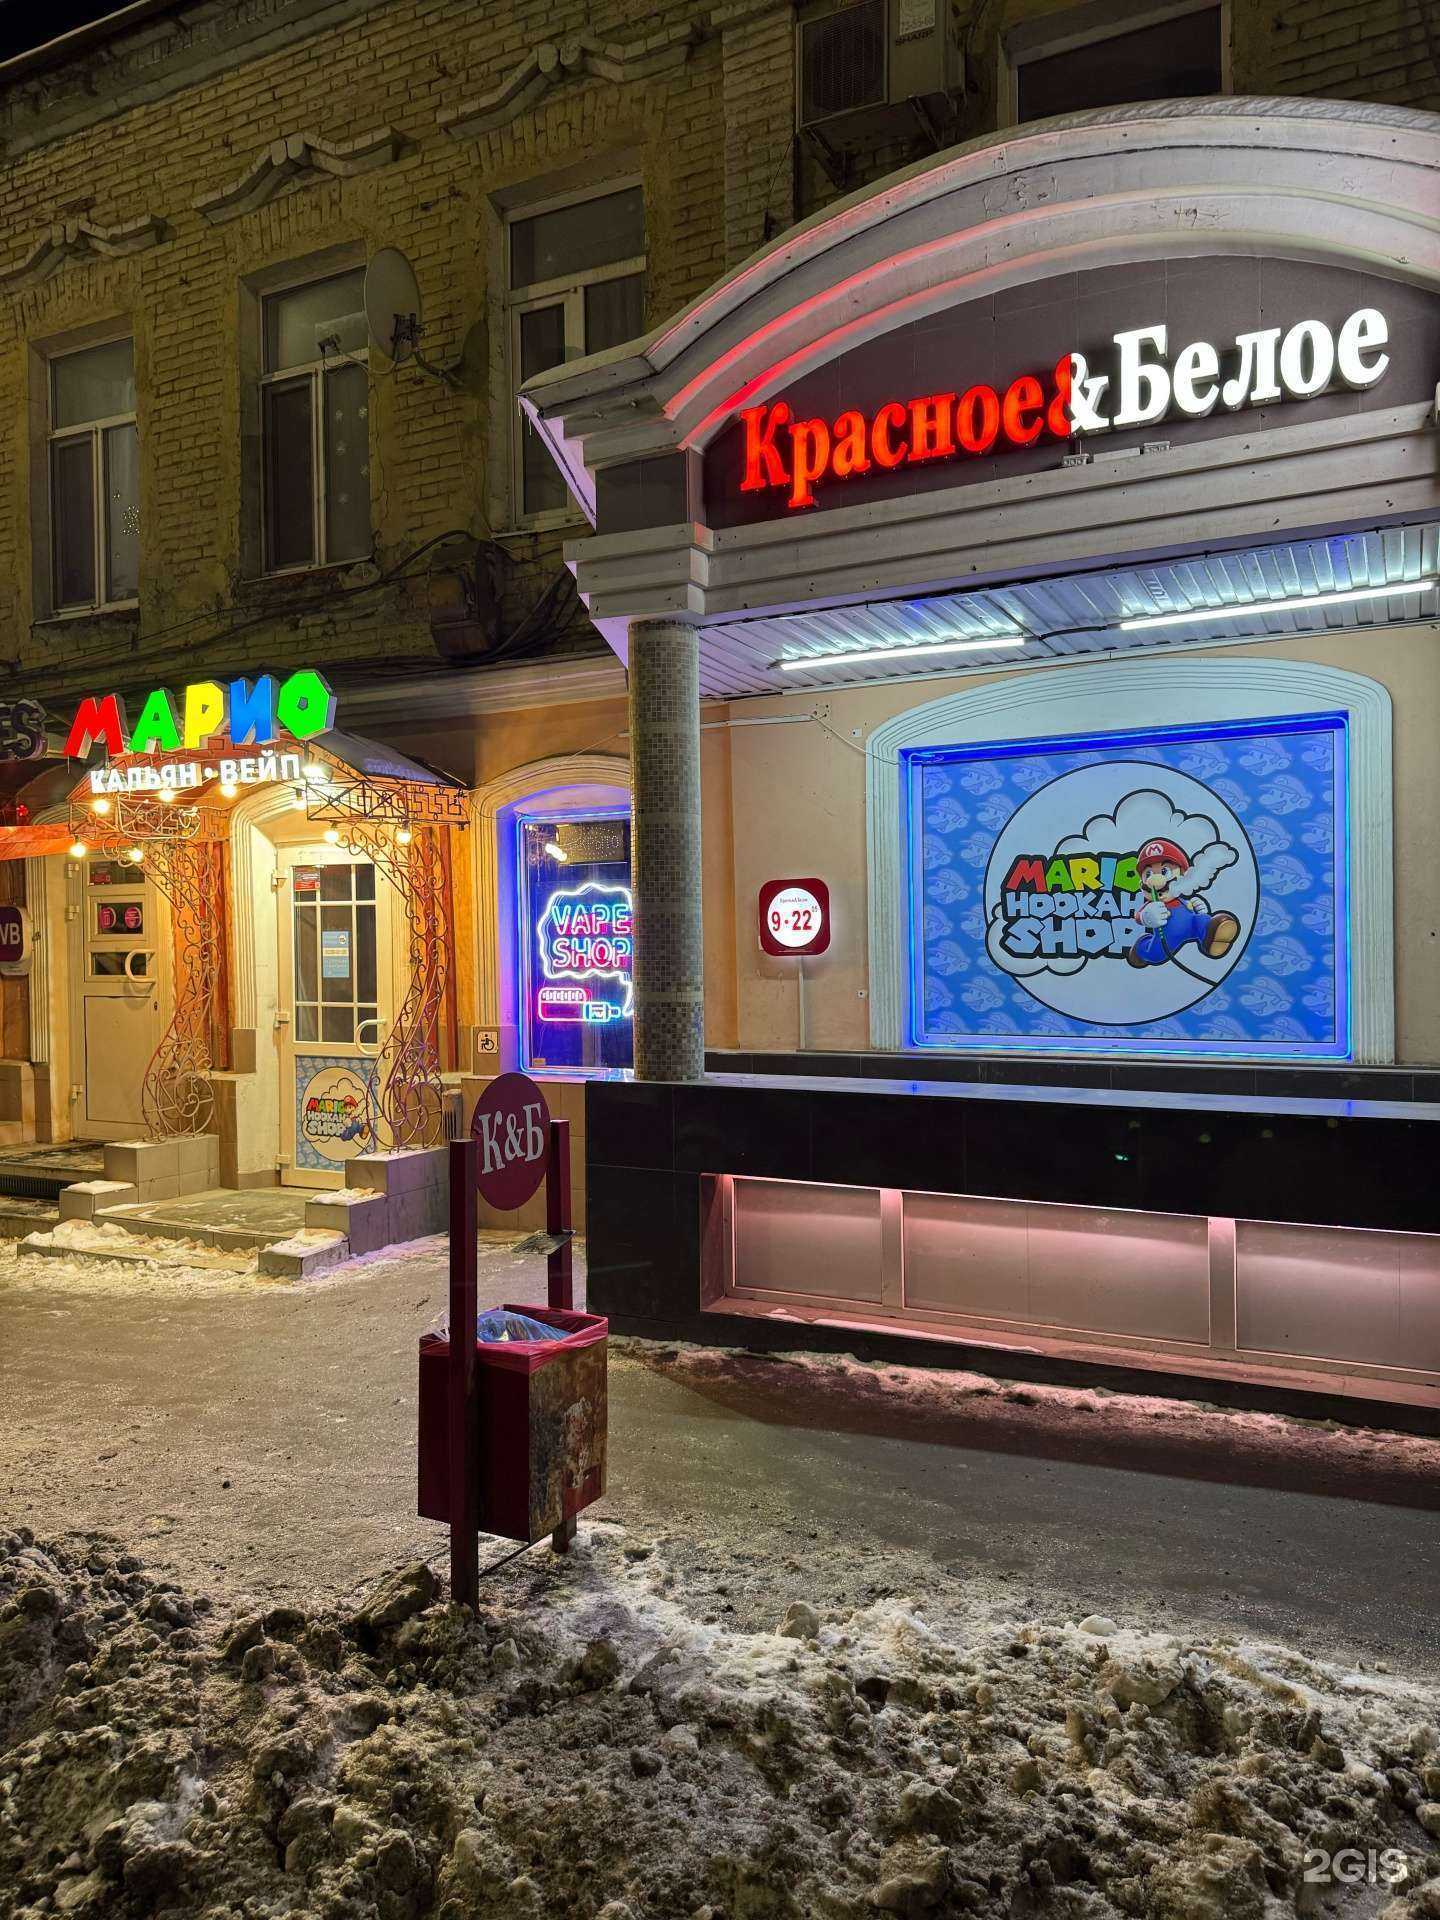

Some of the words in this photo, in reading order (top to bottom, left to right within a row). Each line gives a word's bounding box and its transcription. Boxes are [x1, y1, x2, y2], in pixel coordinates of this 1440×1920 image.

[64, 669, 332, 757] МАРИО
[91, 763, 200, 793] КАЛЬЯН
[220, 751, 300, 784] ВЕЙП
[1004, 856, 1142, 893] MARIO
[552, 904, 631, 935] VAPE
[1006, 892, 1145, 918] HOOKAH
[553, 938, 631, 967] SHOP
[1003, 917, 1147, 955] SHOP
[479, 1103, 544, 1174] К&Б
